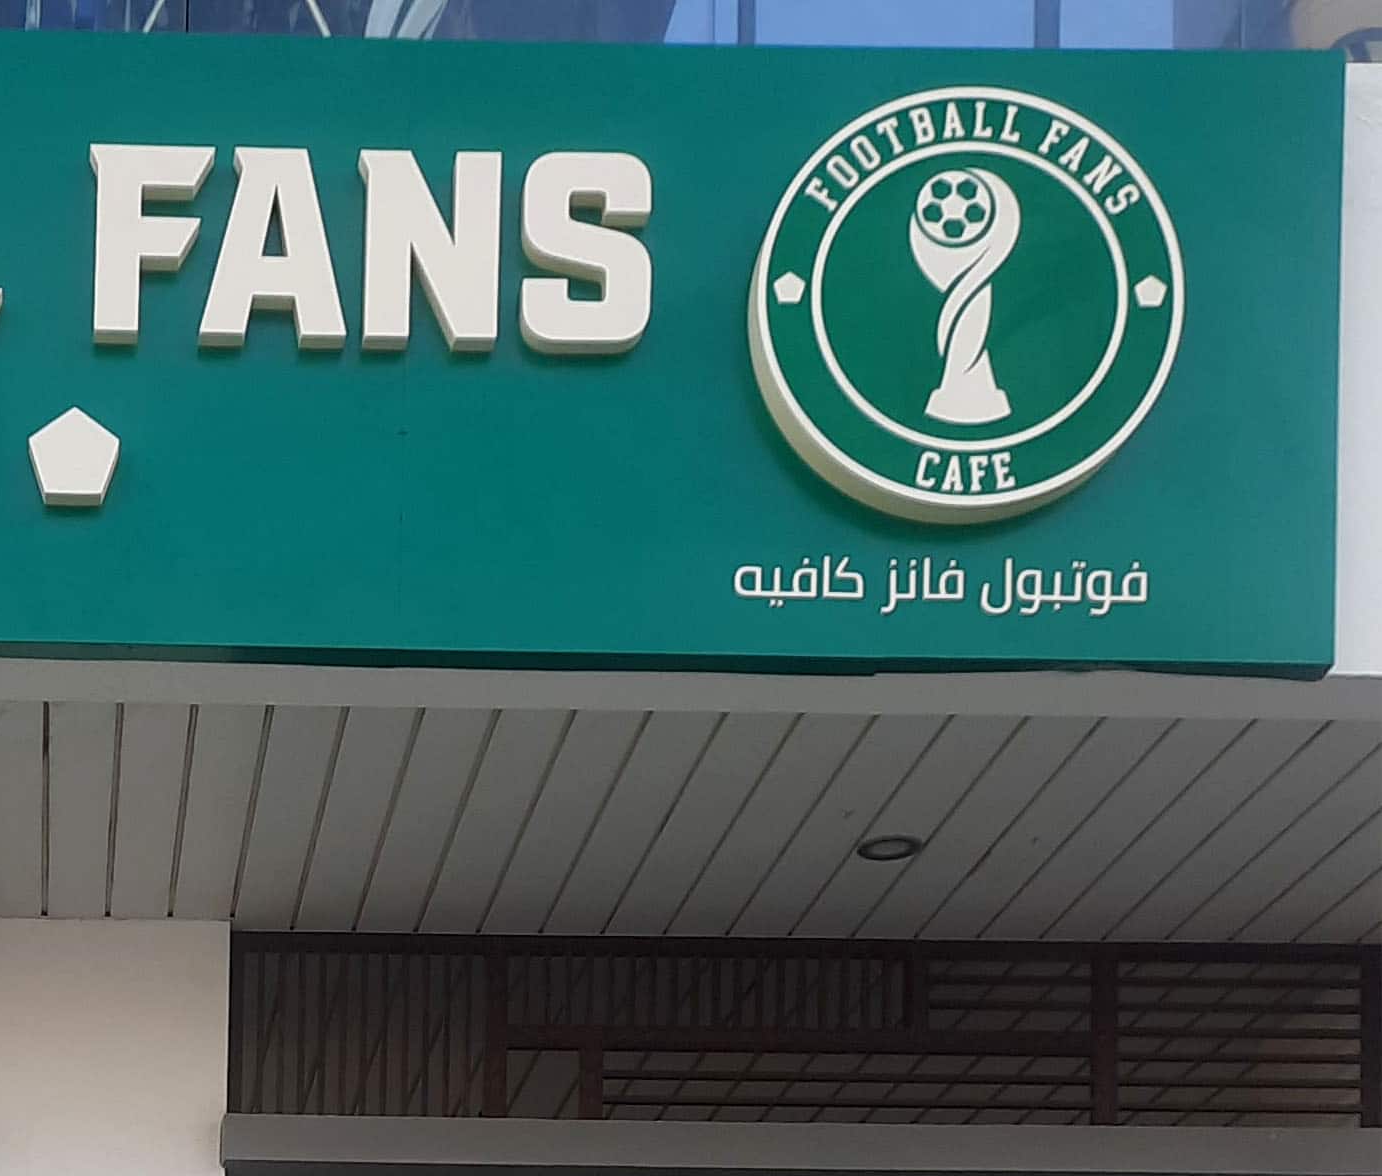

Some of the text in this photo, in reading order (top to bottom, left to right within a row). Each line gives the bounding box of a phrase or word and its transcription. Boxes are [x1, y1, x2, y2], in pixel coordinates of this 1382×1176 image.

[805, 101, 1141, 216] FOOTBALL FANS
[88, 142, 654, 353] FANS
[914, 449, 1017, 494] CAFE
[733, 554, 1149, 616] فوتبول فانز كافيه
